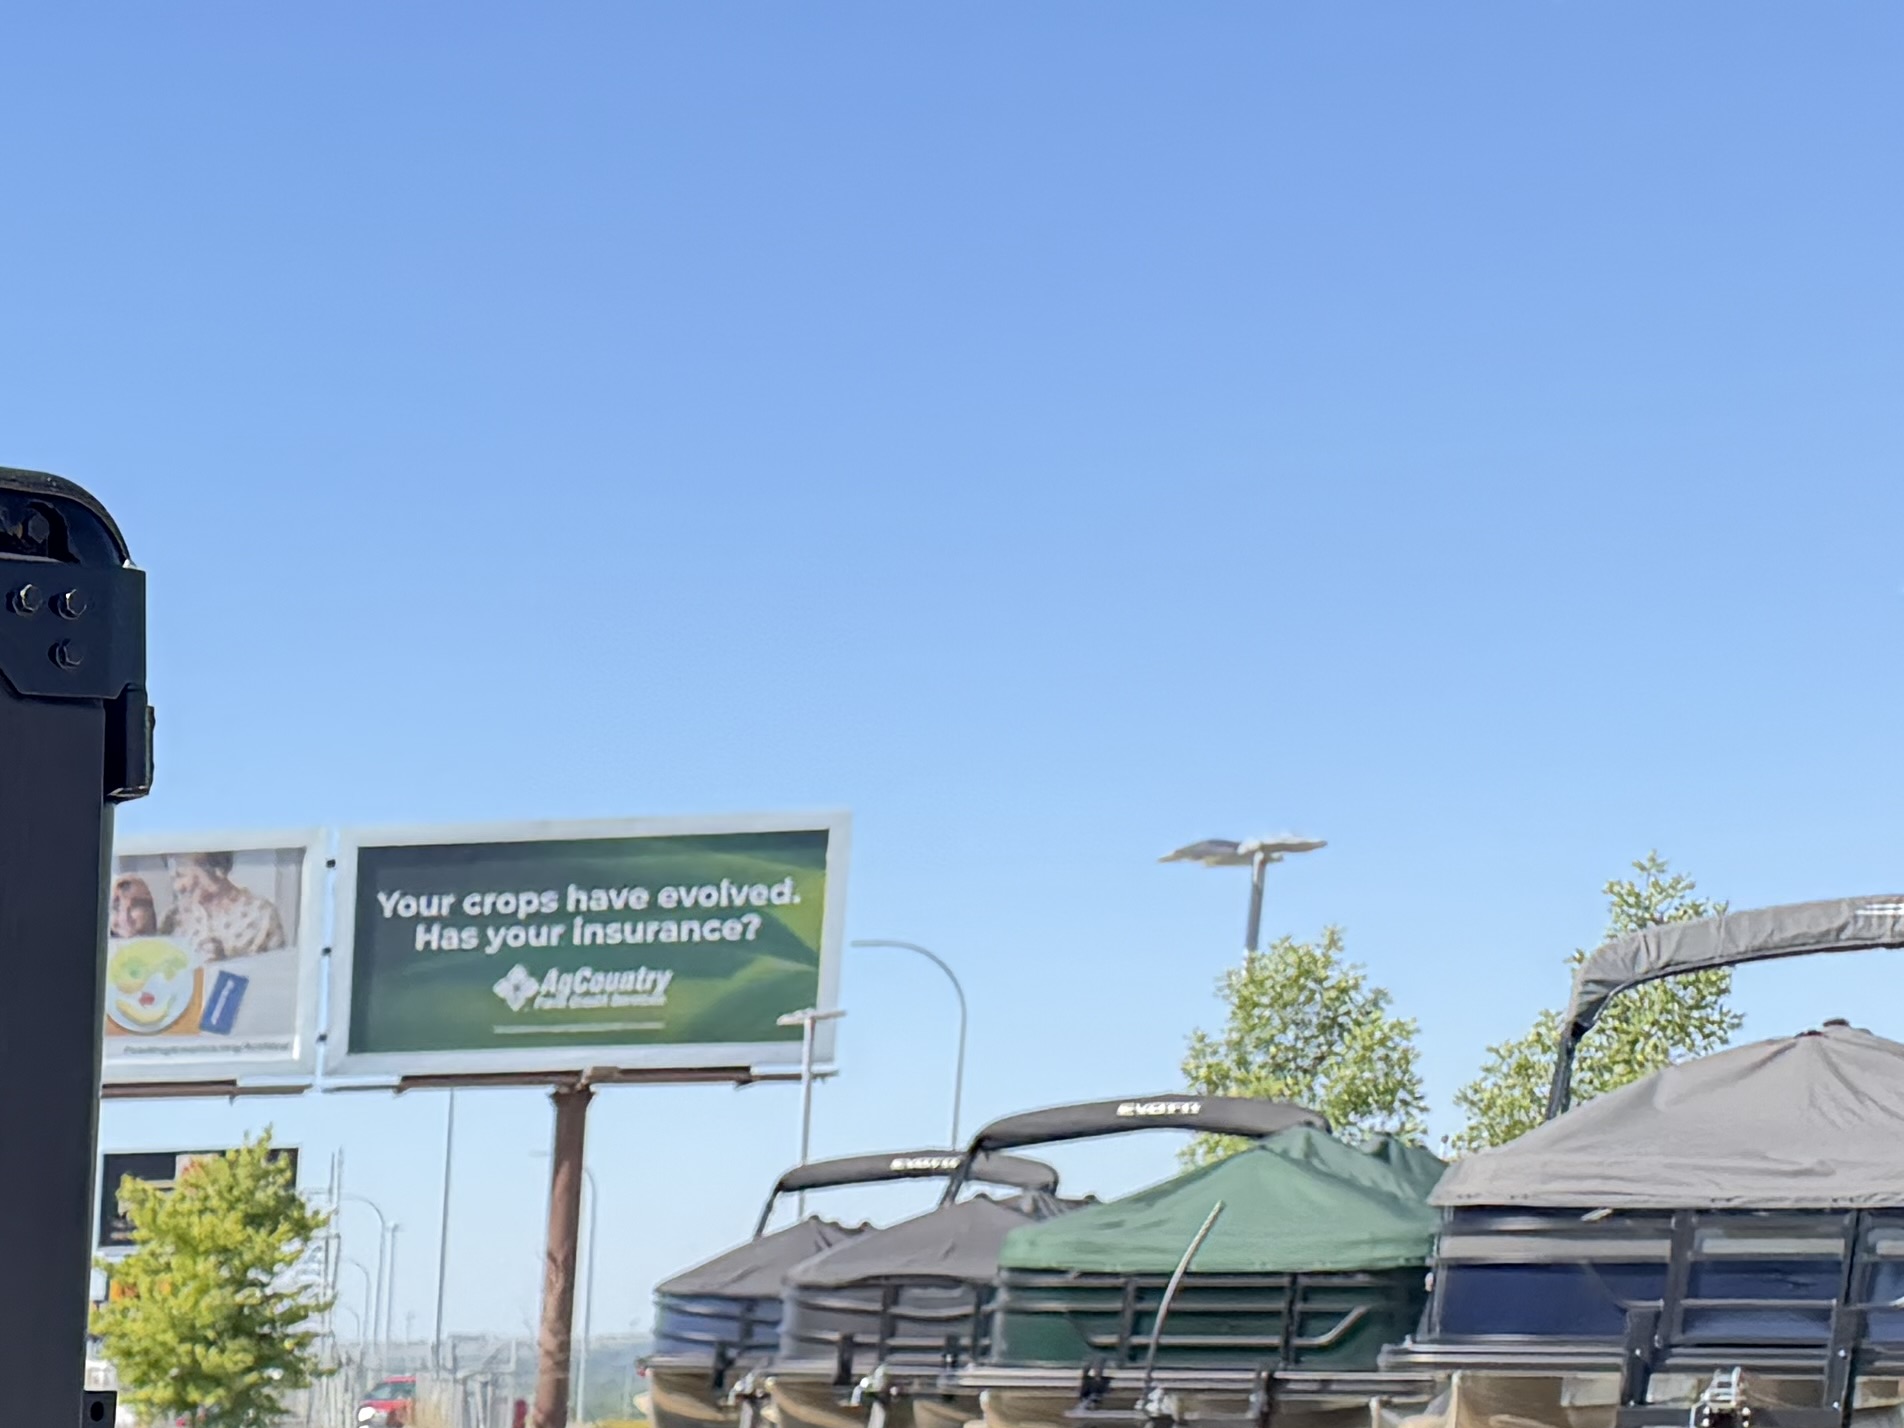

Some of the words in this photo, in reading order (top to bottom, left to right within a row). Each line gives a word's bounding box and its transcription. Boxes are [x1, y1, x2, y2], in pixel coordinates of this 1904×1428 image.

[378, 891, 455, 918] Your
[462, 889, 558, 919] crops
[567, 884, 649, 912] have
[657, 877, 801, 908] evolved.
[415, 922, 479, 952] Has
[485, 920, 565, 954] your
[572, 913, 762, 946] insurance?
[538, 965, 674, 995] AgCountry
